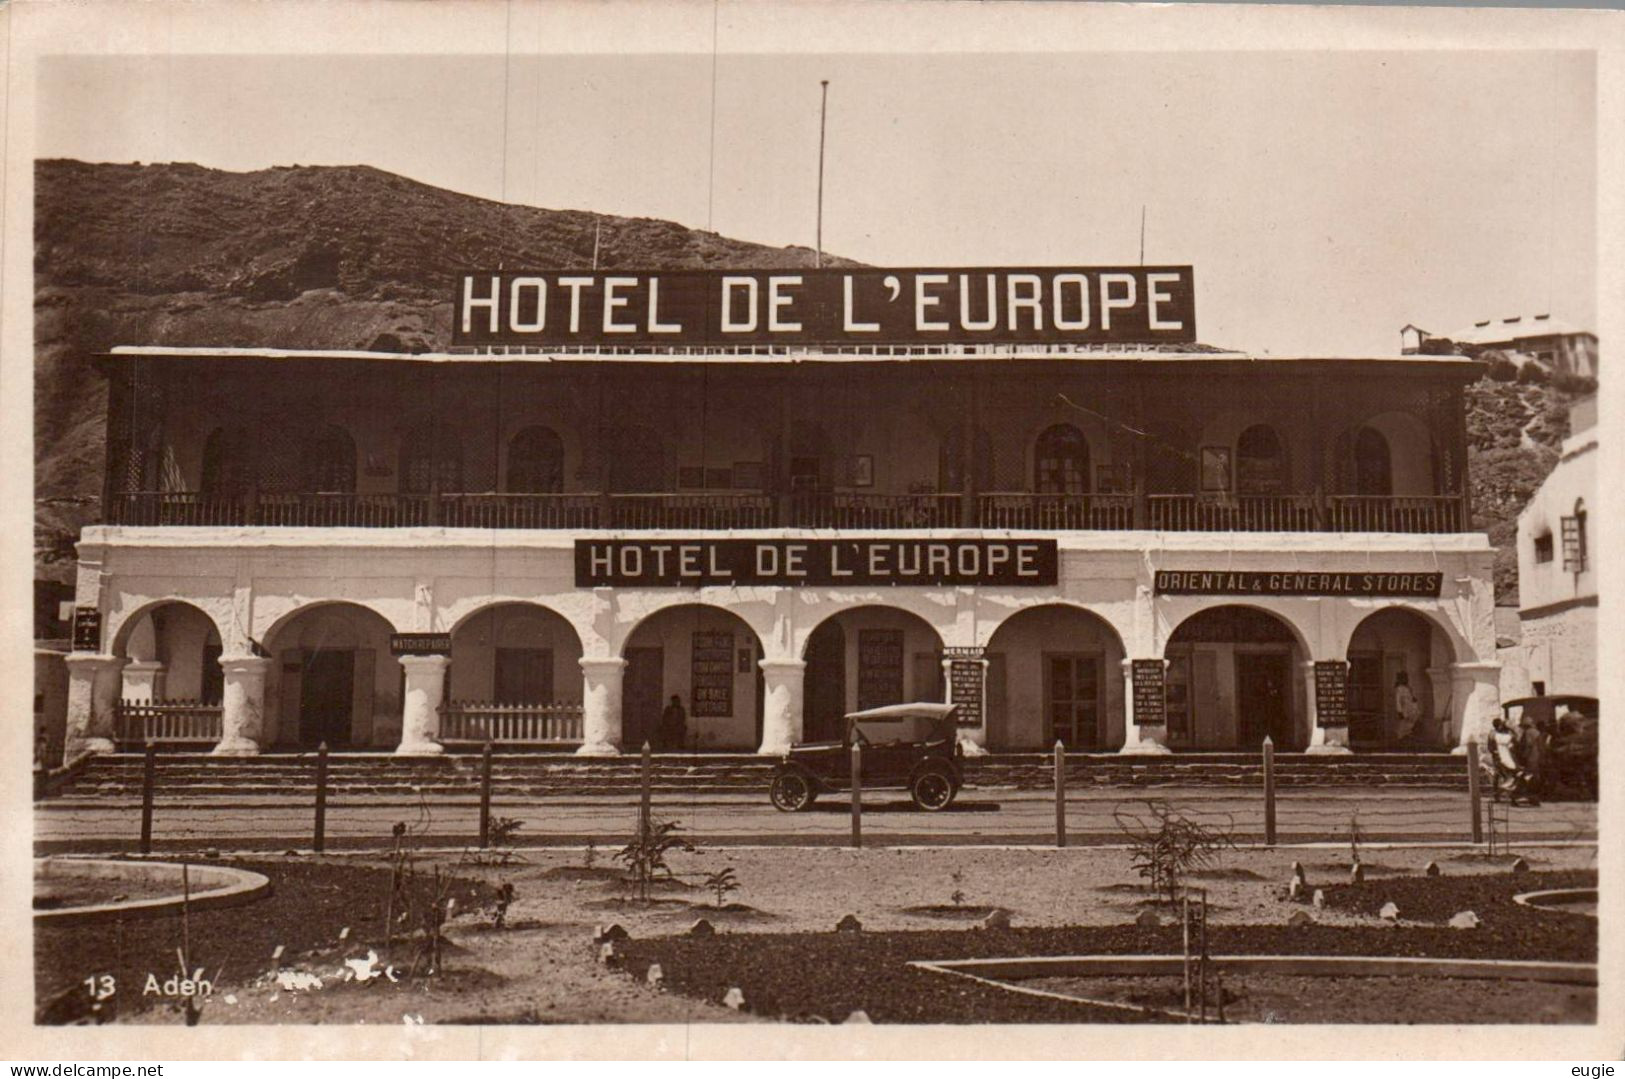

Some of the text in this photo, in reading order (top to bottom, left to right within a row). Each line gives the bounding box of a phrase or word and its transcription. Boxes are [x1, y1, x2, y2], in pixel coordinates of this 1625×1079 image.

[462, 273, 1183, 335] HOTEL DE L'EUROPE
[590, 544, 1040, 577] HOTEL DE L'EUROPE
[1158, 572, 1437, 592] ORIENTAL & GENERAL STORES
